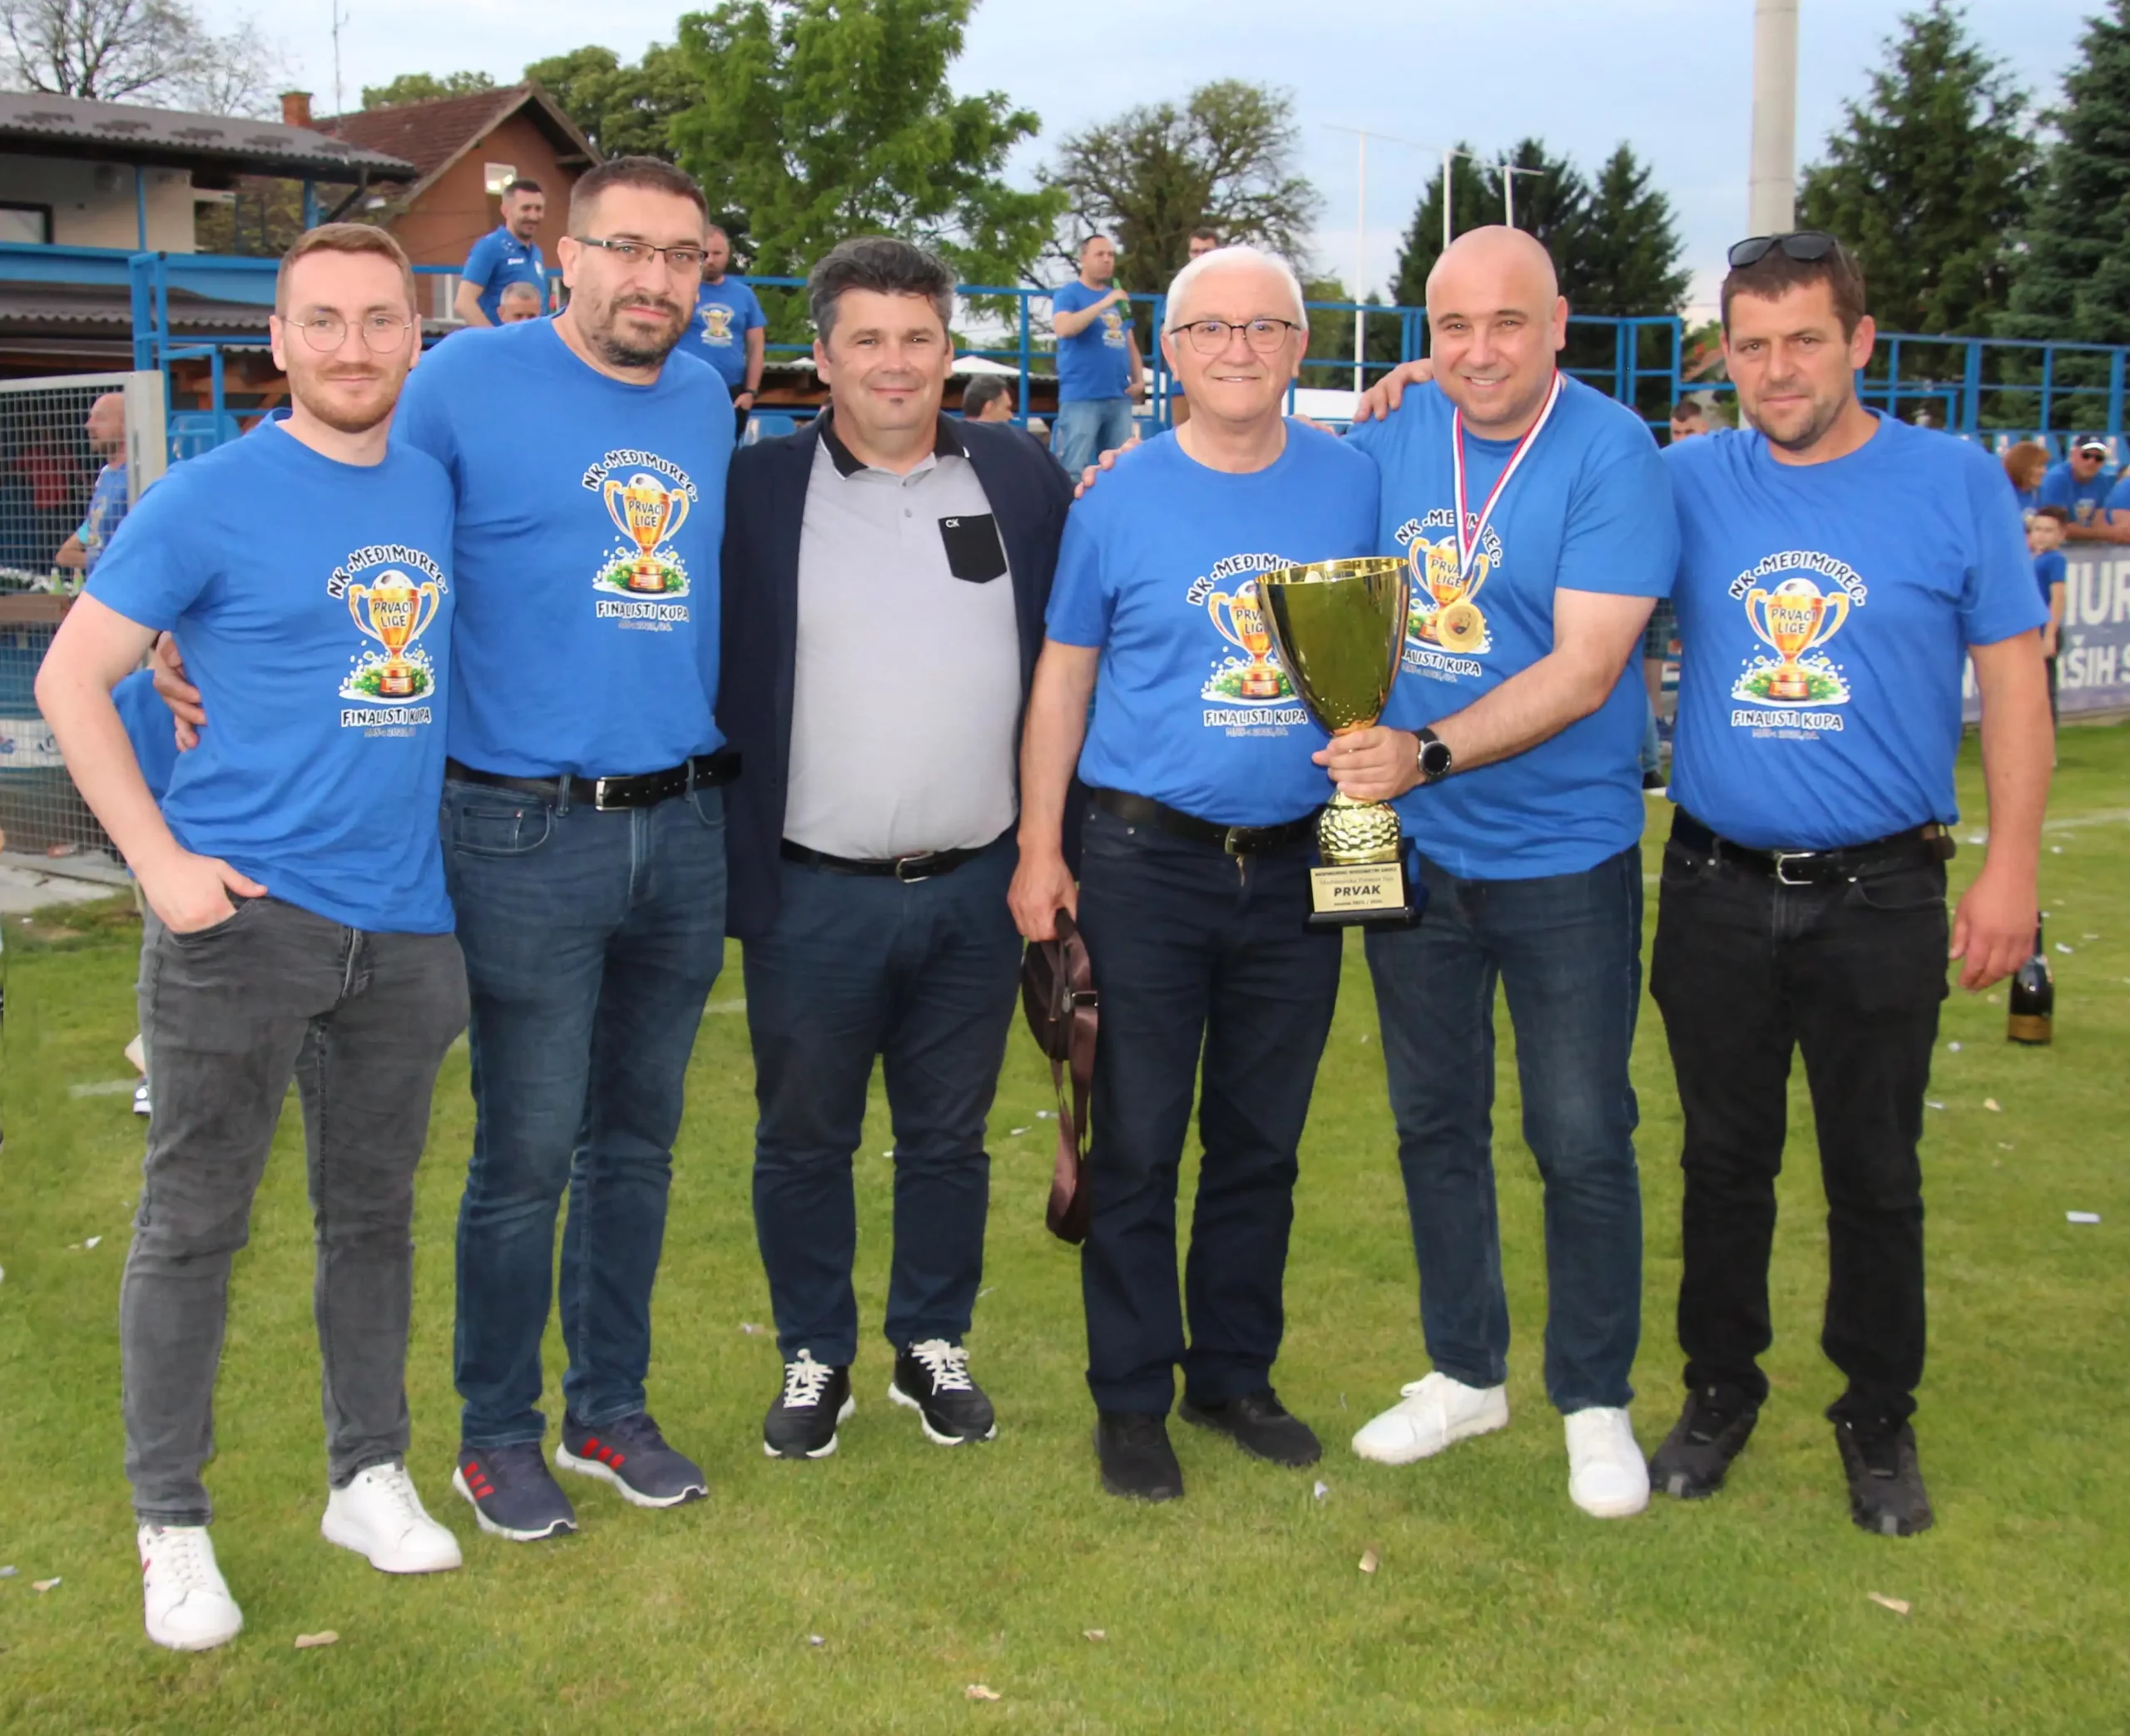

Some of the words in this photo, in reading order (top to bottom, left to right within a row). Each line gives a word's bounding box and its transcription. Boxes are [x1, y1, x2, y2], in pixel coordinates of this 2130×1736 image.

[583, 464, 607, 490] NK
[628, 501, 665, 515] PRVACI
[635, 516, 657, 527] LIGE
[945, 518, 960, 528] CK
[1396, 520, 1422, 544] NK
[329, 569, 350, 597] NK
[1731, 571, 1756, 598] NK
[1188, 578, 1213, 604] NK
[373, 601, 414, 615] PRVACI
[597, 601, 656, 619] FINALISTI
[659, 606, 689, 621] KUPA
[1236, 609, 1262, 621] PRV
[1771, 608, 1817, 621] PRVACI
[380, 615, 407, 628] LIGE
[1245, 622, 1264, 634] LIG
[1778, 622, 1806, 635] LIGE
[1402, 650, 1444, 670] ALISTI
[1446, 658, 1481, 675] KUPA
[341, 708, 408, 727] FINALISTI
[409, 707, 431, 724] KUPA
[1205, 710, 1271, 725] FINALISTI
[1275, 710, 1307, 725] KUPA
[1731, 711, 1800, 726] FINALISTI
[1803, 713, 1843, 730] KUPA
[1334, 885, 1381, 897] PRVAK
